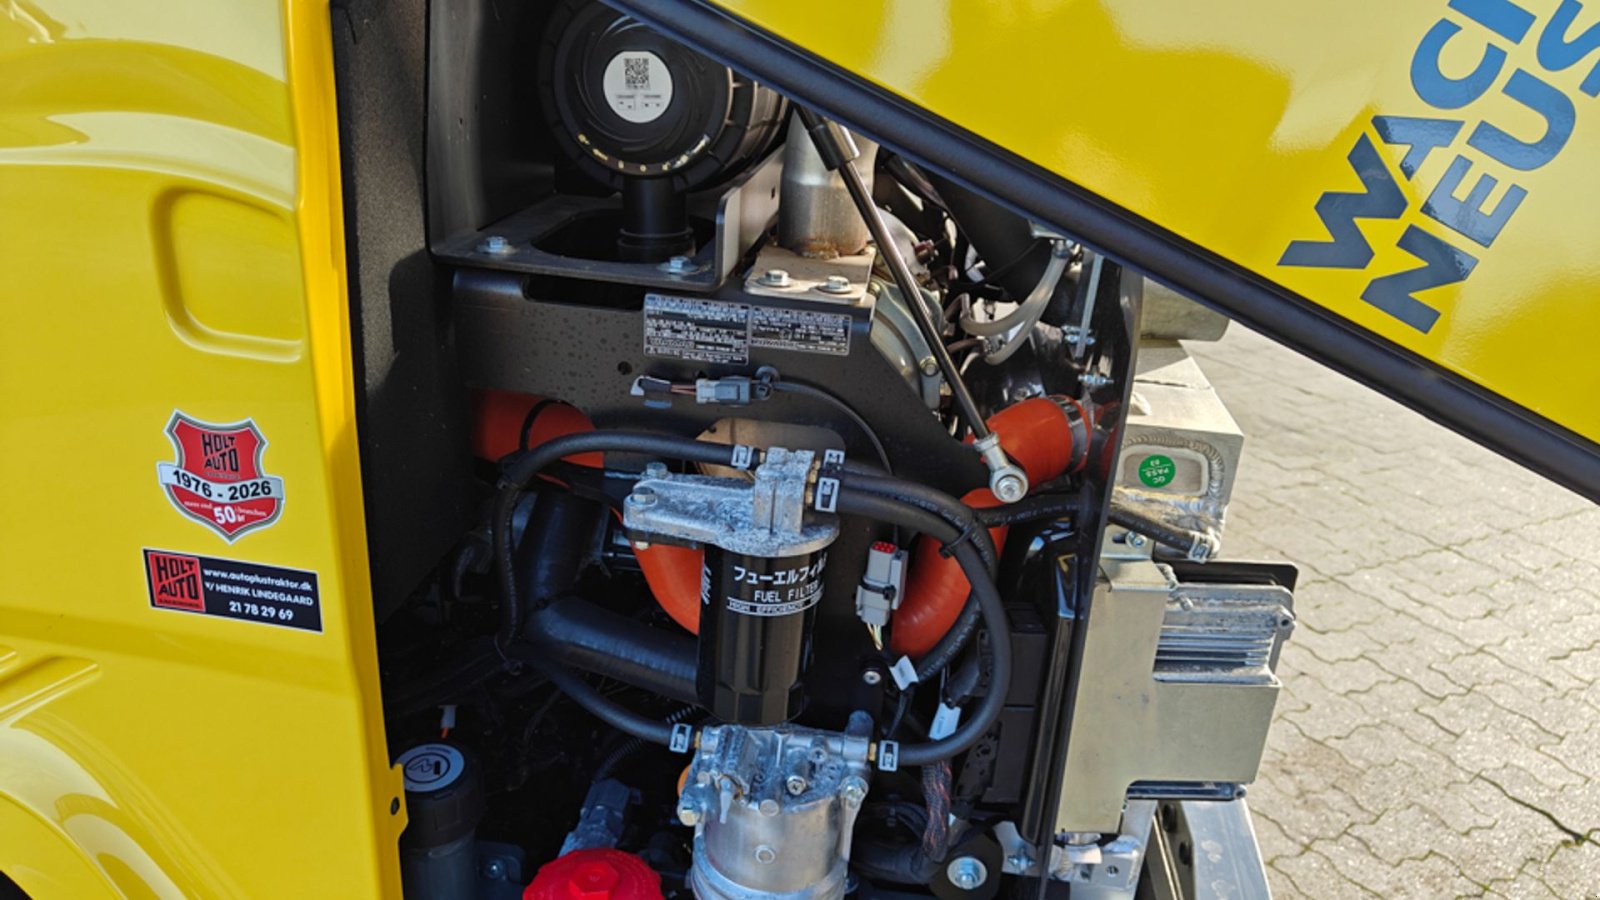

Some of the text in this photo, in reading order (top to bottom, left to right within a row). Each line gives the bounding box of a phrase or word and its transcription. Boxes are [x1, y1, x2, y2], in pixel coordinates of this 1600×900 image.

[202, 432, 235, 457] HOLT
[204, 448, 240, 472] AUTO
[173, 470, 212, 498] 1976
[228, 480, 271, 501] 2026
[213, 505, 236, 525] 50
[155, 555, 195, 583] HOLT
[203, 568, 313, 592] www.autoplustraktor.dk
[159, 573, 200, 600] AUTO
[215, 583, 251, 597] HENRIK
[251, 589, 314, 607] LINDEGAARD
[754, 590, 782, 603] FUEL
[787, 580, 818, 601] FILTER
[229, 601, 294, 621] 21 78 29 69
